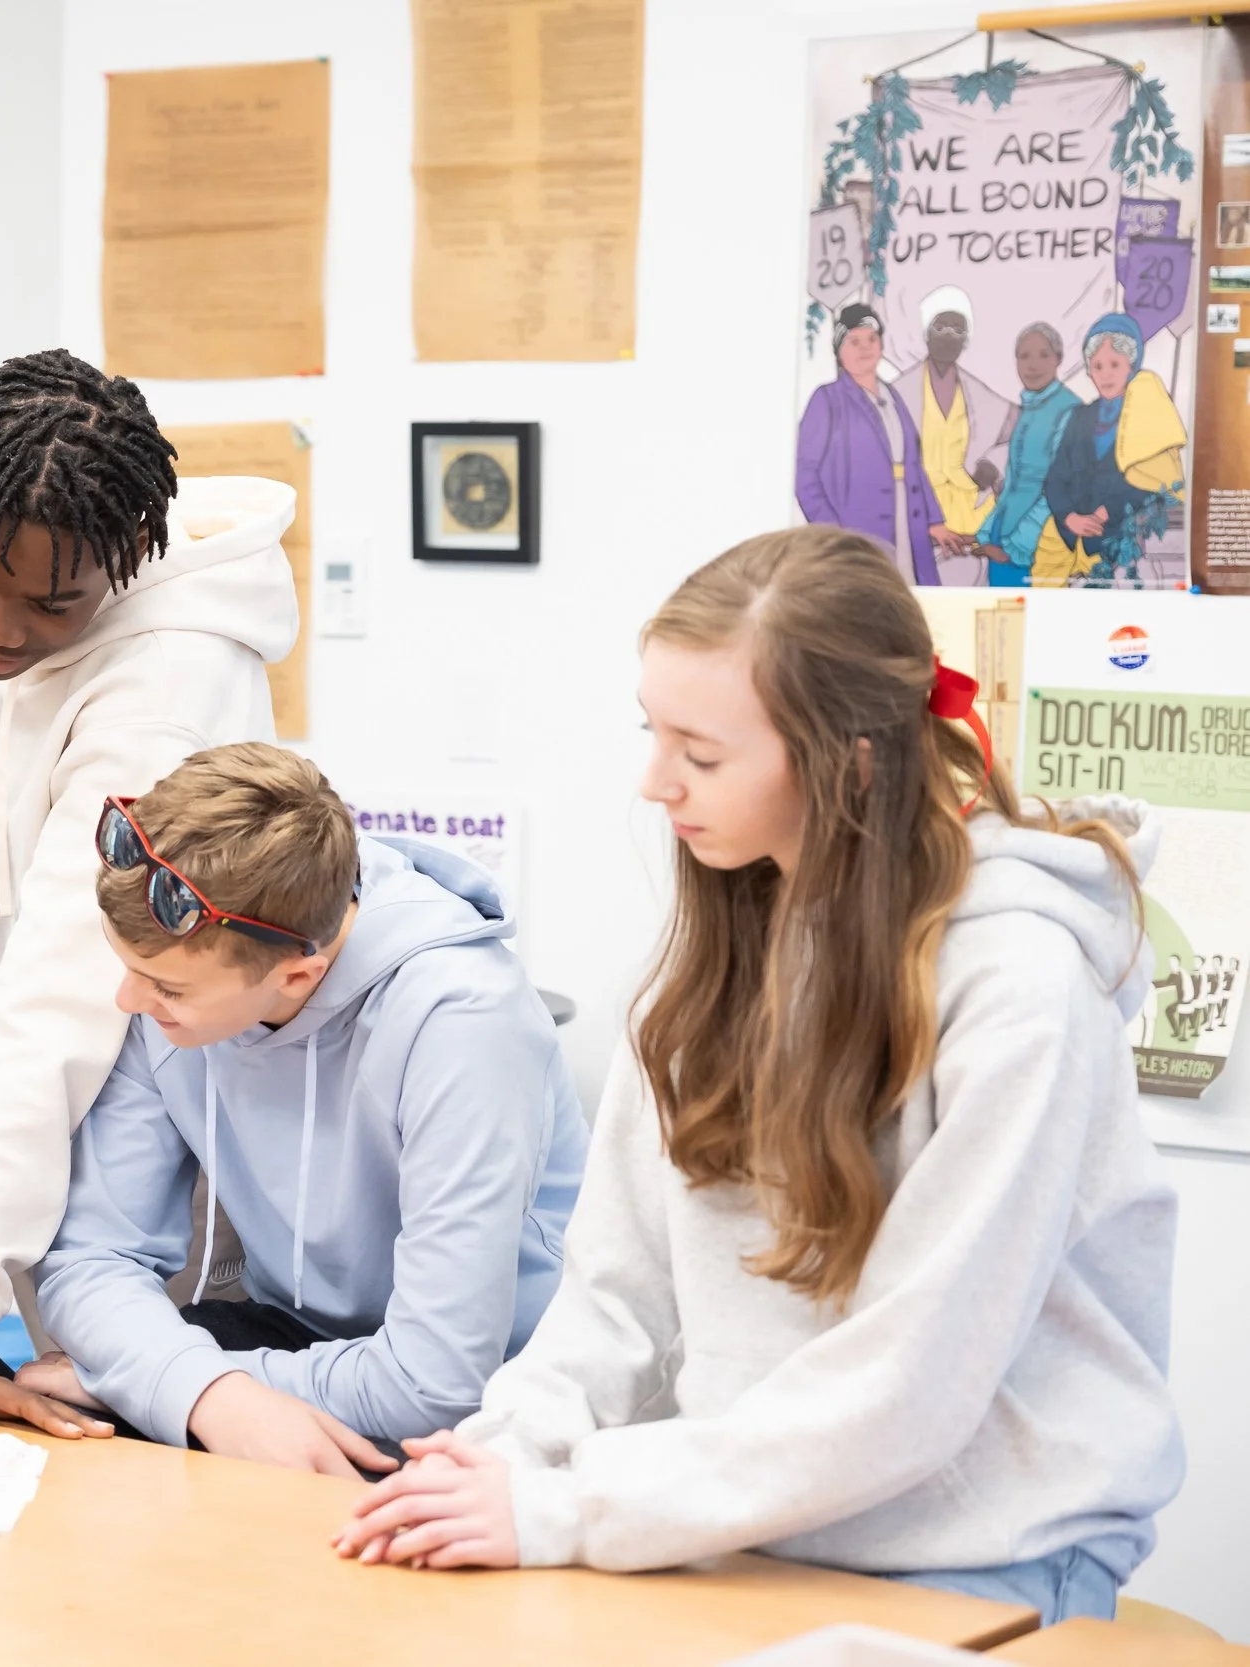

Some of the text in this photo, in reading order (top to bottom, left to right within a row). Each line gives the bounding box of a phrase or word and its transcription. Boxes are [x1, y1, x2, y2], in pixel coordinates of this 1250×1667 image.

[909, 129, 1086, 172] WE ARE
[897, 177, 1109, 216] ALL BOUND
[821, 224, 846, 256] 19
[892, 232, 937, 263] UP
[947, 227, 1113, 263] TOGETHER
[817, 258, 853, 289] 20
[1138, 256, 1175, 284] 20
[1134, 282, 1173, 311] 20
[1040, 699, 1188, 754] DOCKUM
[1039, 751, 1125, 792] SIT-IN
[1140, 756, 1218, 780] WICHITA
[446, 813, 505, 838] seat
